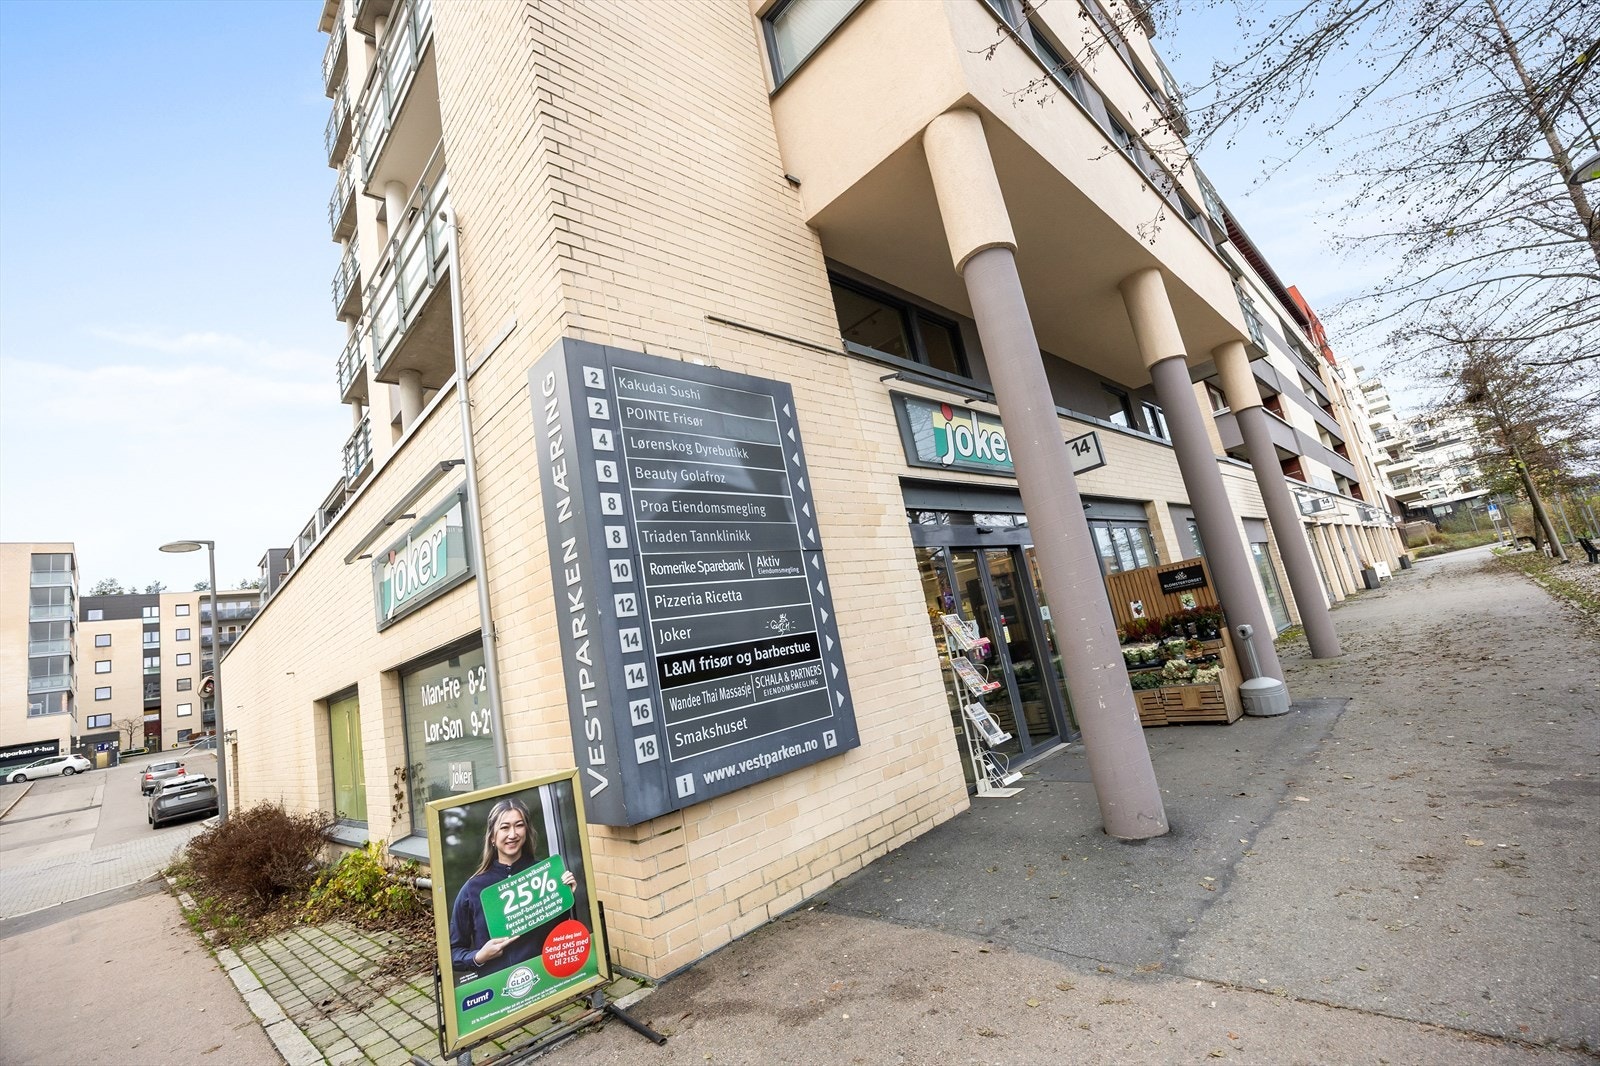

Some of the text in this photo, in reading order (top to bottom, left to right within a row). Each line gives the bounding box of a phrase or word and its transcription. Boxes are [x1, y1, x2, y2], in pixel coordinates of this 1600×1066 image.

[590, 372, 599, 384] 2
[618, 376, 701, 400] Kakudai Sushi
[594, 402, 604, 415] 2
[626, 406, 704, 427] POINTE Frisør
[598, 434, 608, 446] 4
[940, 402, 1013, 466] joke
[630, 436, 750, 459] Lørenskog Dyrebutikk
[1071, 438, 1091, 457] 14
[603, 464, 612, 478] 6
[634, 466, 726, 484] Beauty Golafroz
[608, 497, 617, 510] 8
[640, 500, 767, 518] Proa Eiendomsmegling
[612, 530, 622, 544] 8
[642, 530, 752, 543] Triaden Tannklinikk
[650, 558, 746, 576] Romerike Sparebank
[756, 555, 780, 568] Aktiv
[758, 566, 800, 575] Eiendomsmegling
[386, 529, 443, 621] joker
[614, 564, 629, 578] 10
[541, 370, 610, 798] VESTPARKEN NÆRING
[618, 598, 634, 612] 12
[654, 590, 743, 608] Pizzeria Ricetta
[622, 632, 640, 648] 14
[659, 627, 692, 645] Joker
[664, 641, 811, 678] L&M frisør og barberstue
[628, 668, 645, 684] 14
[754, 664, 823, 689] SCHALA & PARTNERS
[763, 678, 819, 697] EIENDOMSMEGLING
[669, 682, 752, 712] Wandee Thai Massasje
[633, 704, 650, 720] 16
[674, 717, 749, 748] Smakshuset
[0, 746, 55, 758] stparken P-hus
[638, 740, 656, 757] 18
[703, 738, 819, 785] www.vestparken.no
[450, 763, 472, 790] joker
[498, 884, 510, 892] Litt
[526, 862, 551, 879] velkomst!
[500, 871, 557, 915] 25%
[506, 892, 560, 922] Trumf-bonus på din
[506, 897, 563, 930] første handel som ny
[511, 905, 563, 936] Joker GLAD-kunde
[545, 937, 589, 954] Send SMS med
[565, 933, 573, 941] deg
[550, 946, 585, 960] ordet GLAD
[554, 955, 580, 966] til 2155.
[510, 974, 530, 986] GLAD
[466, 991, 490, 1007] trumf
